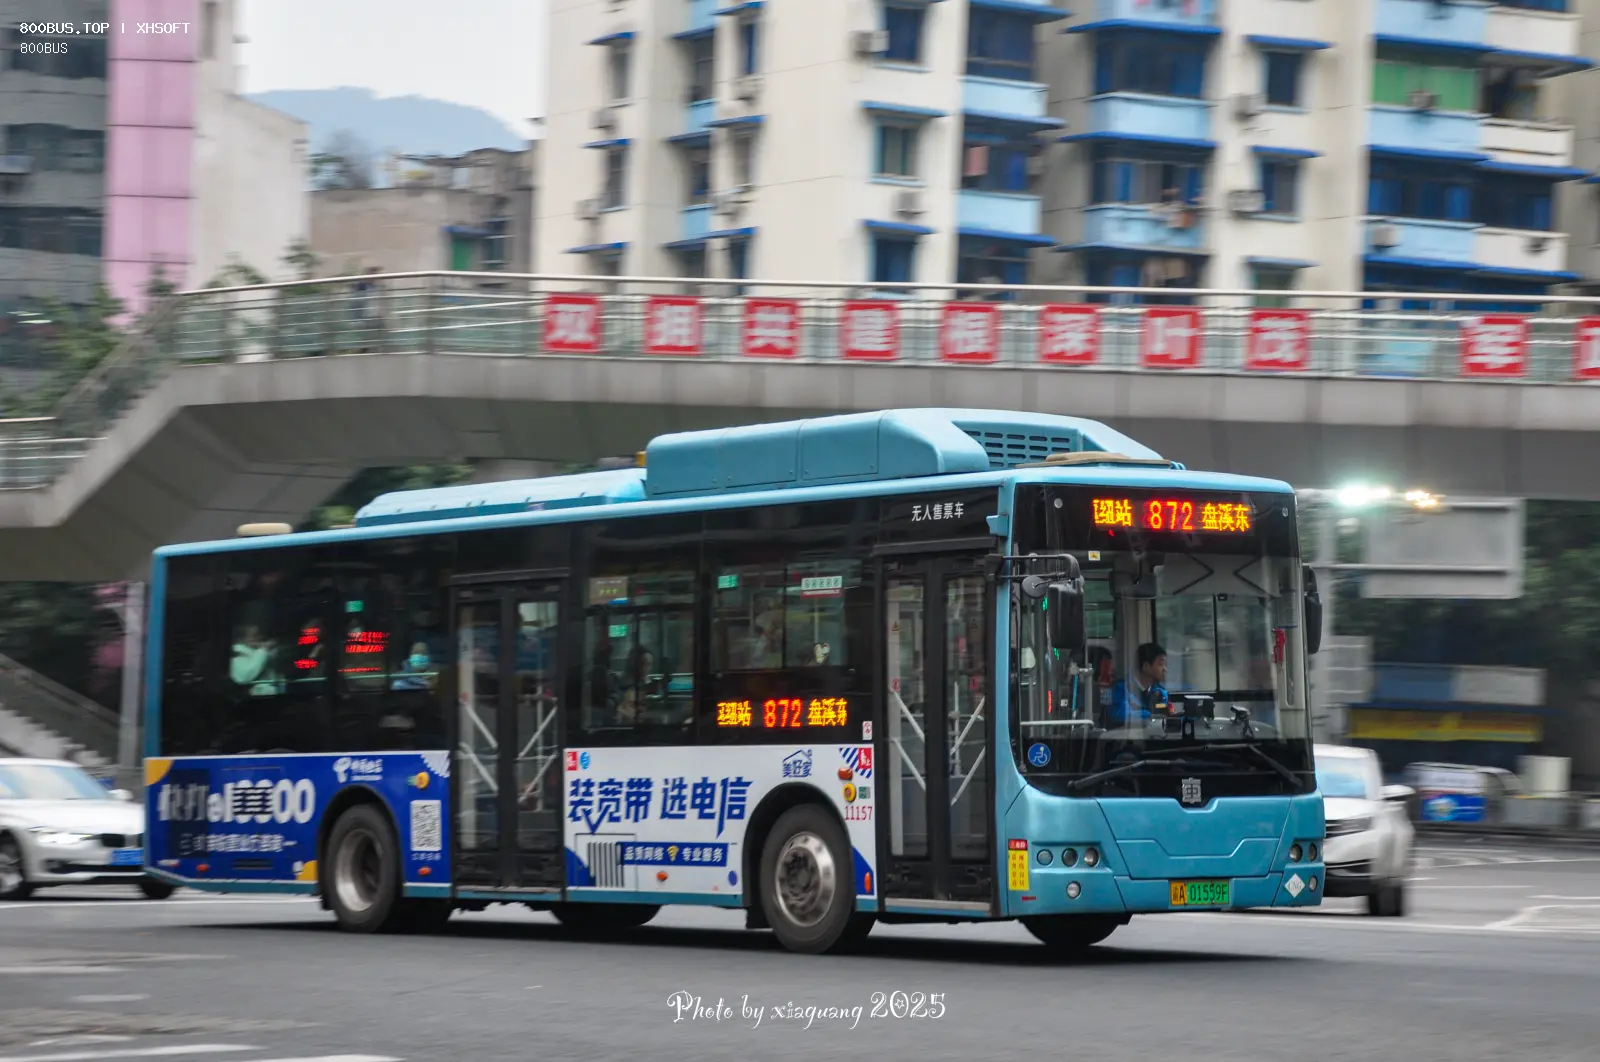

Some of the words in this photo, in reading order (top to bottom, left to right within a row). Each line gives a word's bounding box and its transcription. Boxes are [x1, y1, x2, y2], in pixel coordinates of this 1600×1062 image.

[911, 502, 964, 522] 无人售票车
[1149, 500, 1194, 531] 872
[1201, 502, 1250, 532] 盘溪东
[763, 699, 803, 728] 872
[807, 698, 848, 727] 盘溪东
[568, 778, 653, 835] 装宽带
[660, 777, 753, 838] 选电信
[845, 806, 873, 821] 11157
